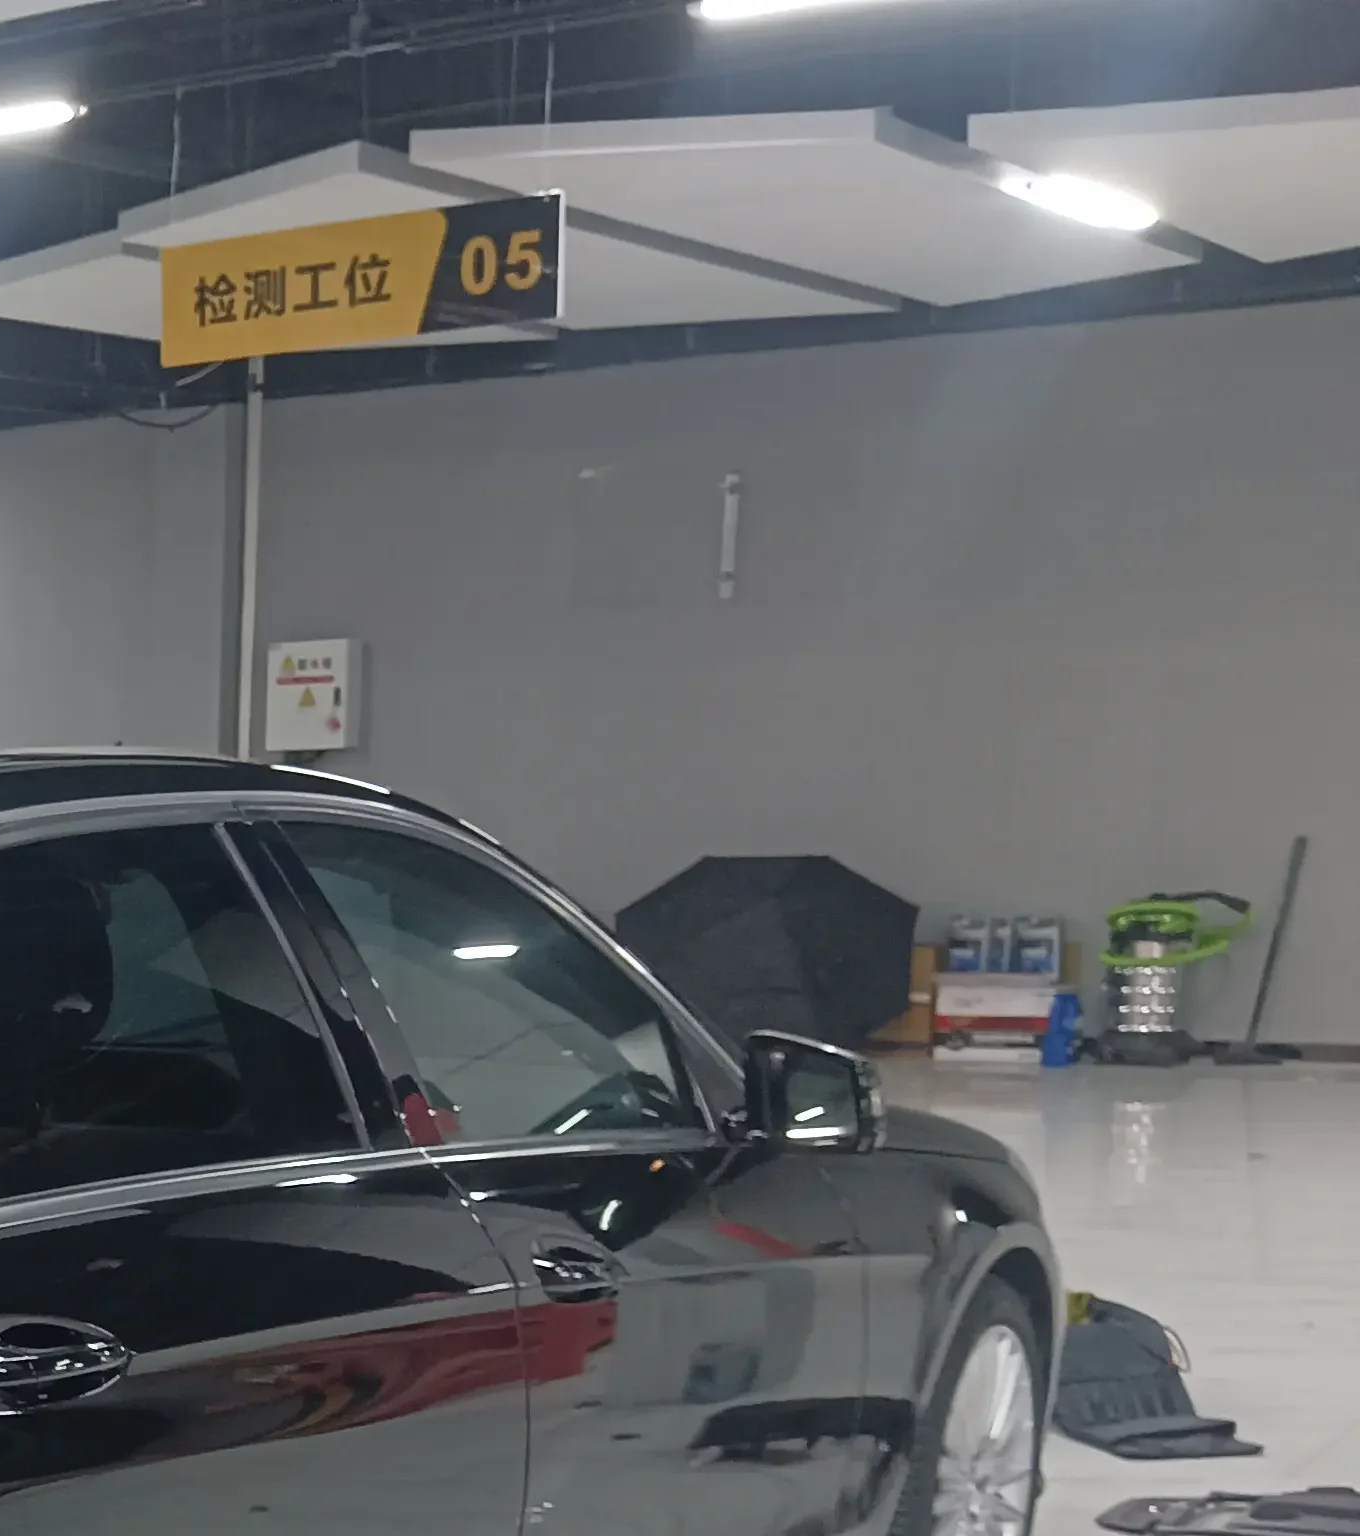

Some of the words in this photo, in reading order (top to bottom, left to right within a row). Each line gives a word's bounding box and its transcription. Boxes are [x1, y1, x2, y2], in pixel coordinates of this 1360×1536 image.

[194, 253, 392, 328] 检测工位
[460, 229, 544, 297] 05
